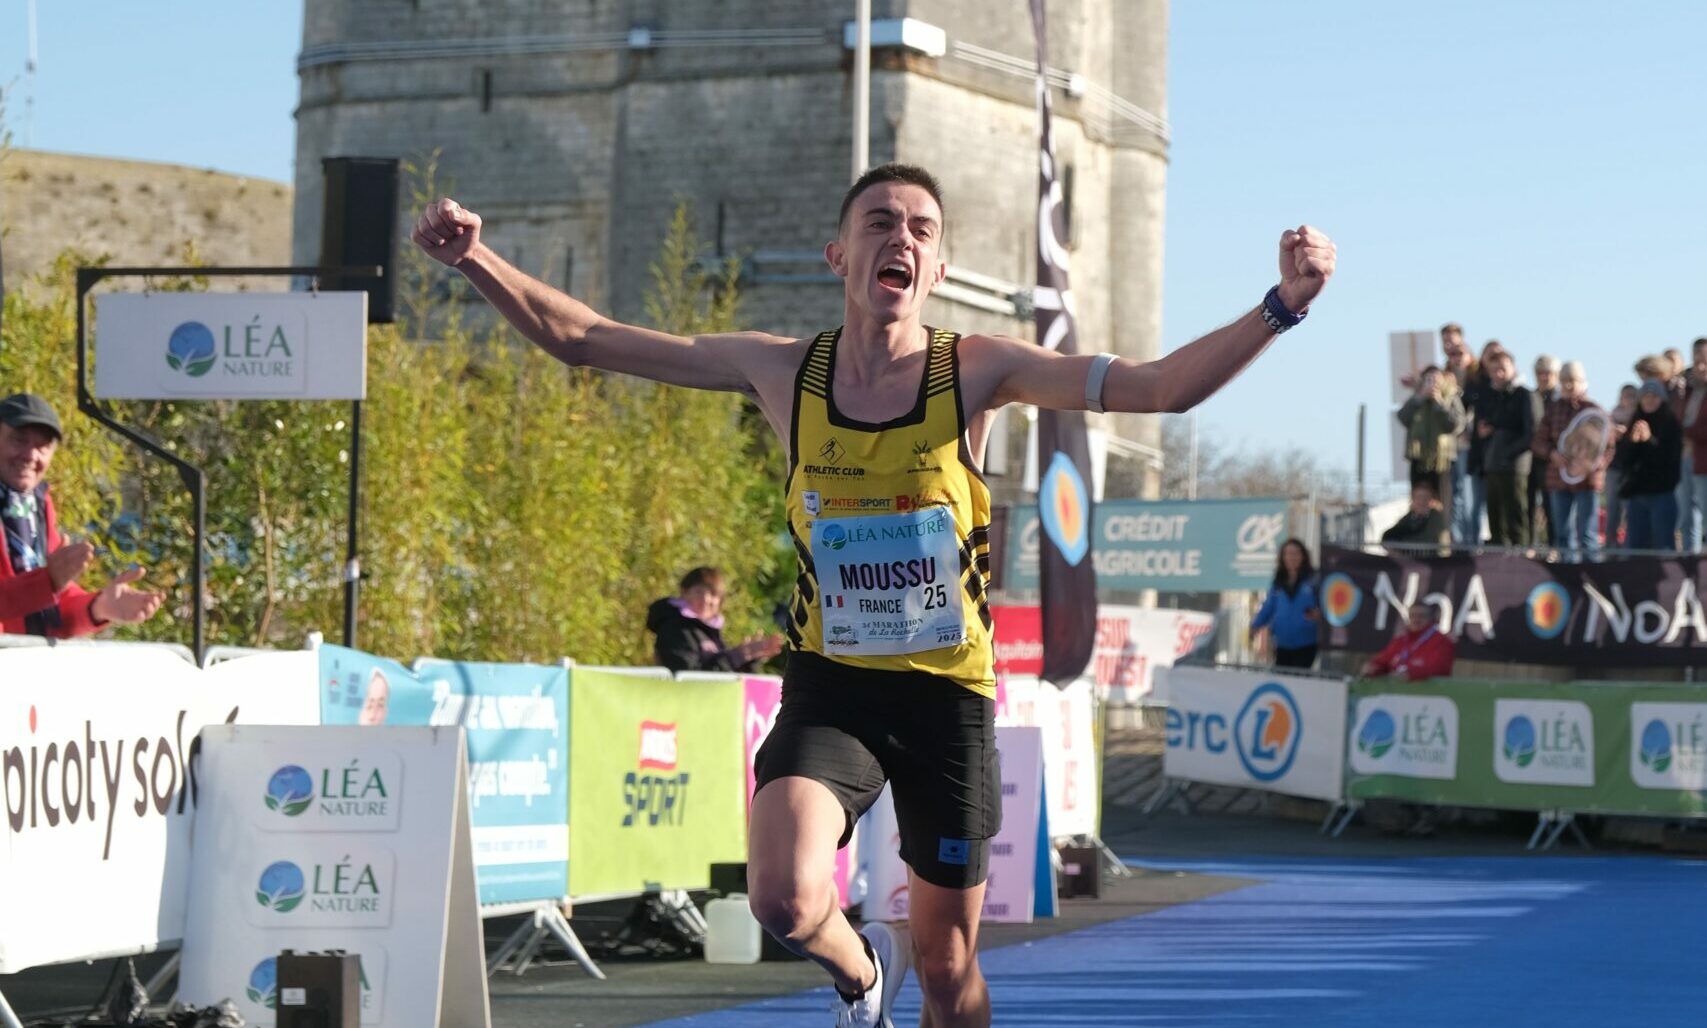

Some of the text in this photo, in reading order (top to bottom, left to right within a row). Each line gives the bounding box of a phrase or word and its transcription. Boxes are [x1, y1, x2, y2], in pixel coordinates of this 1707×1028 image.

[223, 313, 292, 358] LÉA
[223, 361, 293, 377] NATURE
[803, 465, 865, 476] ATHLETIC CLUB
[831, 498, 891, 508] INTERSPORT
[848, 519, 945, 543] LÉA NATURE
[1103, 512, 1189, 542] CRÉDIT
[838, 556, 936, 591] MOUSSU
[859, 584, 947, 614] FRANCE 25
[872, 617, 924, 629] MARATHON
[937, 631, 962, 643] 2025
[1401, 704, 1449, 747] LÉA
[1541, 710, 1586, 752] LÉA
[3, 704, 124, 861] picoty
[320, 758, 388, 799] LÉA
[319, 802, 388, 817] NATURE
[622, 771, 690, 827] SPORT
[312, 854, 380, 896] LÉA
[310, 898, 380, 914] NATURE
